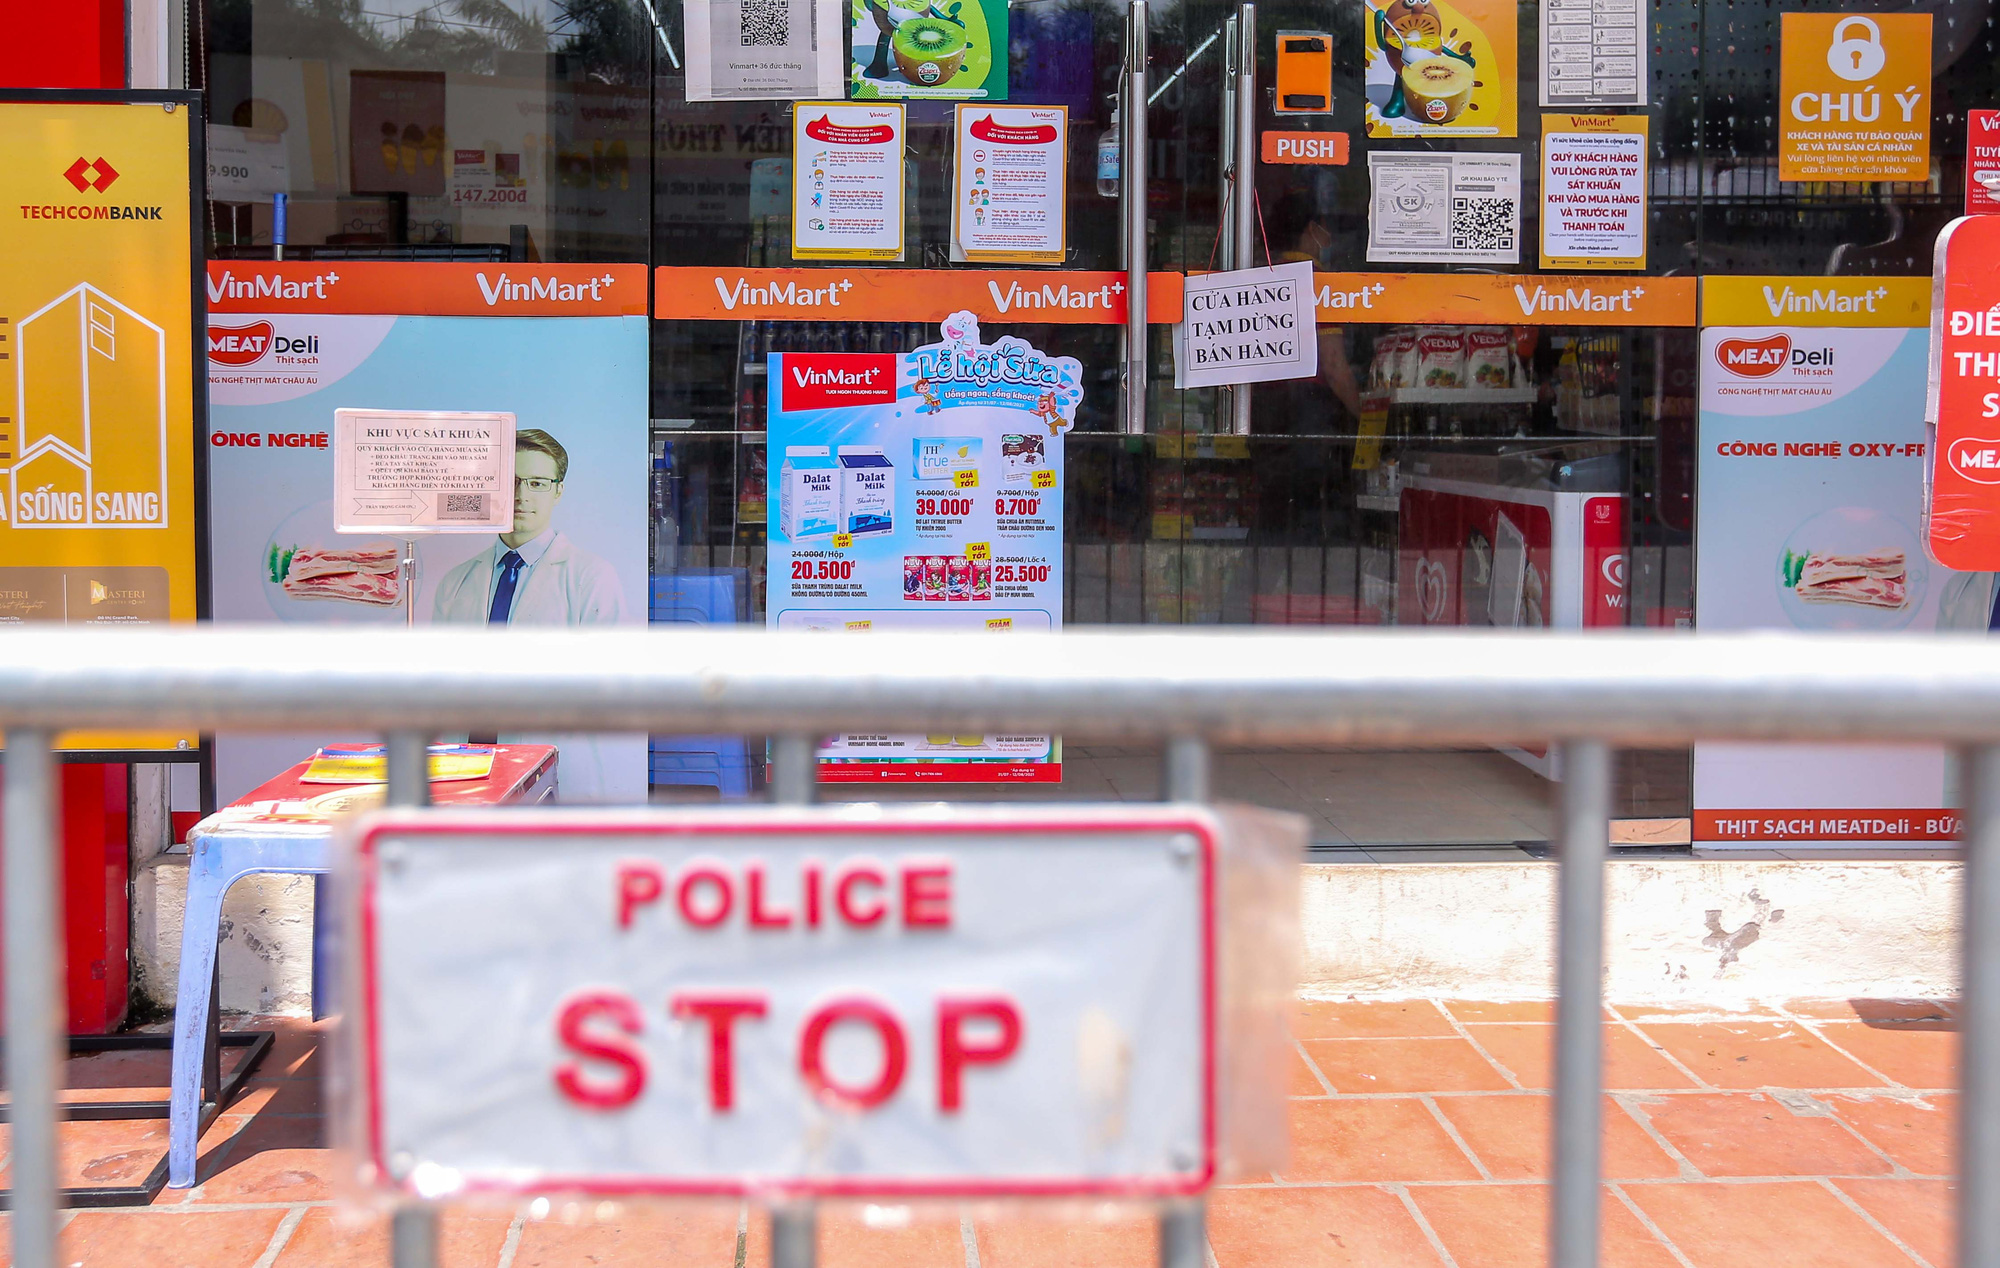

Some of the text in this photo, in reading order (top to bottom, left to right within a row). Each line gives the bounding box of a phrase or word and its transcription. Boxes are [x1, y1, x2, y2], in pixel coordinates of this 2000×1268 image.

[1790, 85, 1921, 122] CHÚ Ý
[1570, 116, 1616, 128] VinMart+
[1787, 130, 1922, 140] KHÁCH HÀNG TỰ BẢO QUẢN
[1277, 138, 1334, 158] PUSH
[1796, 142, 1912, 152] XE VÀ TÀI SẢN CÁ NHÂN
[1551, 152, 1638, 162] QUÝ KHÁCH HÀNG
[1787, 154, 1921, 164] Vui lòng liên hệ với nhân viên
[1551, 166, 1638, 176] VUI LÒNG RỬA TAY
[1820, 164, 1843, 174] hàng
[1884, 165, 1907, 173] khóa
[1567, 178, 1620, 190] SÁT KHUẨN
[454, 190, 527, 202] 147.200đ
[1548, 193, 1640, 204] KHI VÀO MUA HÀNG
[20, 206, 162, 220] TECHCOMBANK
[1560, 206, 1627, 217] VÀ TRƯỚC KHI
[1562, 221, 1625, 231] THANH TOÁN
[207, 271, 339, 303] VinMart+
[476, 272, 614, 306] VinMart+
[714, 276, 852, 310] VinMart+
[988, 280, 1124, 314] VinMart+
[1192, 286, 1291, 312] CỬA HÀNG
[1514, 284, 1644, 316] VinMart+
[1762, 286, 1888, 317] VinMart+
[1192, 312, 1294, 340] TẠM DỪNG
[208, 336, 319, 353] MEAT Deli
[1423, 338, 1460, 349] VEDAN
[1472, 334, 1506, 344] VEDAN
[1195, 339, 1293, 363] BÁN HÀNG
[1728, 348, 1833, 366] MEAT Deli
[276, 356, 318, 366] Thịt sạch
[920, 350, 1059, 384] Lễ hội Sữa
[793, 367, 880, 388] VinMart+
[1792, 367, 1833, 377] Thịt sạch
[945, 388, 966, 399] Uống
[967, 390, 990, 398] ngon,
[992, 388, 1011, 400] sống
[1718, 386, 1832, 396] CÔNG NGHỆ THỊT MÁT CHÂU ÂU
[366, 428, 393, 437] KHU
[396, 428, 421, 440] VỰC
[423, 428, 446, 438] SÁT
[268, 431, 328, 450] NGHỆ
[924, 446, 938, 454] TH
[1717, 440, 1777, 457] CÔNG
[1783, 441, 1841, 460] NGHỆ
[923, 456, 948, 467] true
[803, 474, 831, 483] Dalat
[856, 473, 885, 482] Dalat
[961, 479, 974, 487] TỐT
[1038, 479, 1052, 487] TỐT
[865, 482, 885, 490] Milk
[20, 484, 82, 521] SỐNG
[95, 492, 158, 521] SANG
[916, 498, 974, 515] 39.000đ
[995, 498, 1041, 515] 8.700đ
[792, 550, 844, 559] 24.000đ/Hộp
[972, 552, 986, 560] TỐT
[792, 560, 856, 579] 20.500đ
[995, 565, 1051, 582] 25.500đ
[1715, 820, 1759, 838] THỊT
[1764, 820, 1814, 838] SẠCH
[1820, 819, 1909, 834] MEATDeli
[617, 861, 955, 929] POLICE
[553, 991, 1025, 1115] STOP
